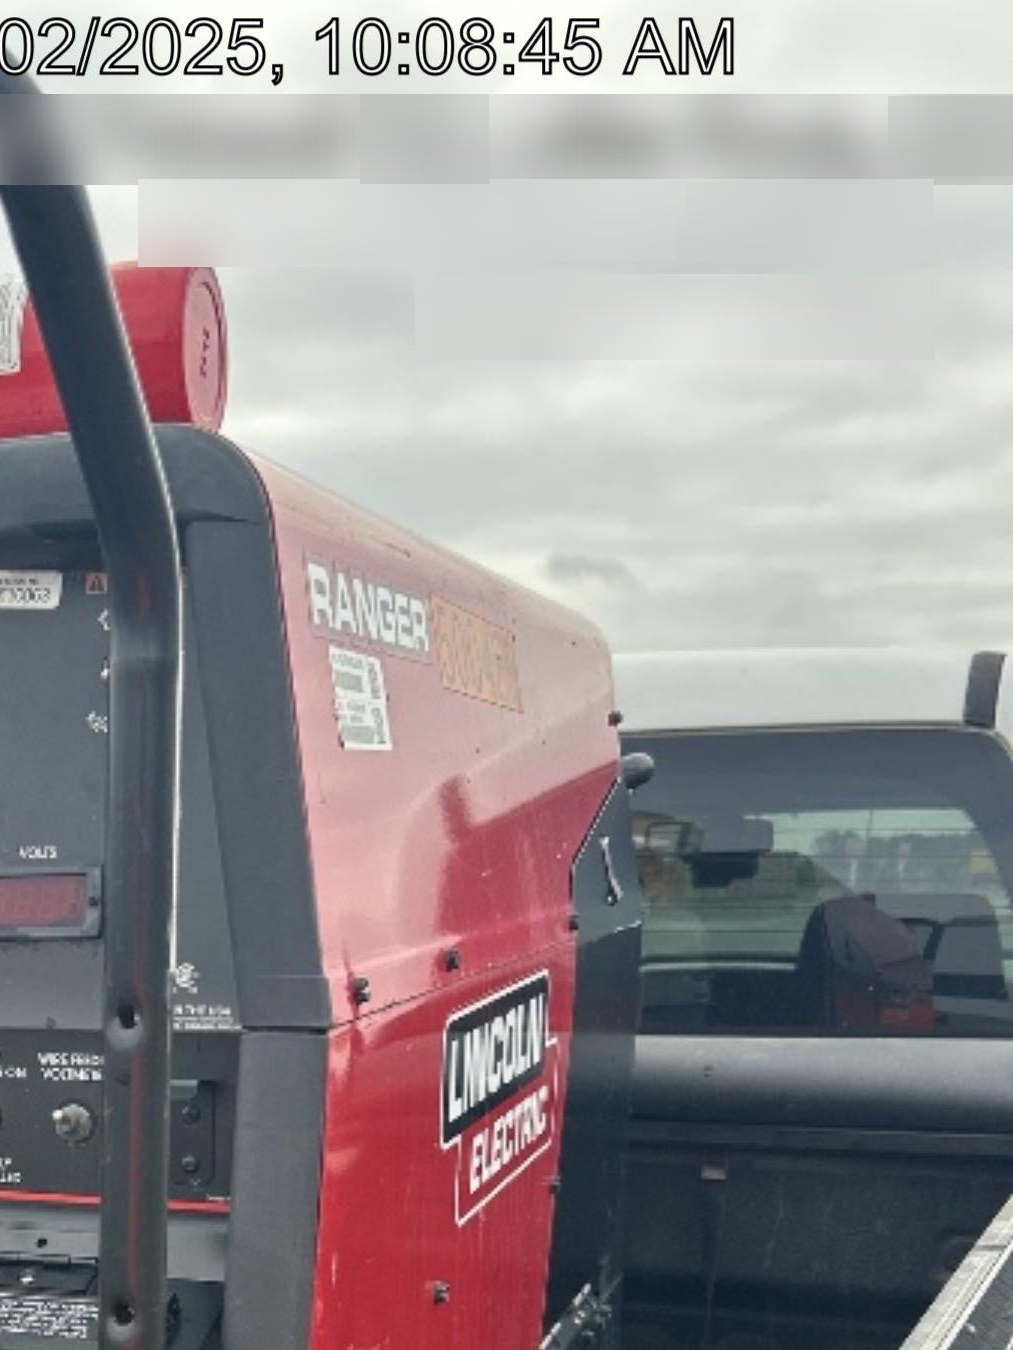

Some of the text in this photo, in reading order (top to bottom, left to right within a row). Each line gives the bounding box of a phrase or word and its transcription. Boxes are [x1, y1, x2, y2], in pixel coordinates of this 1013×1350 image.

[307, 561, 430, 652] RANGER
[447, 992, 545, 1123] LINCOLN
[468, 1084, 550, 1195] ELECTRIC
